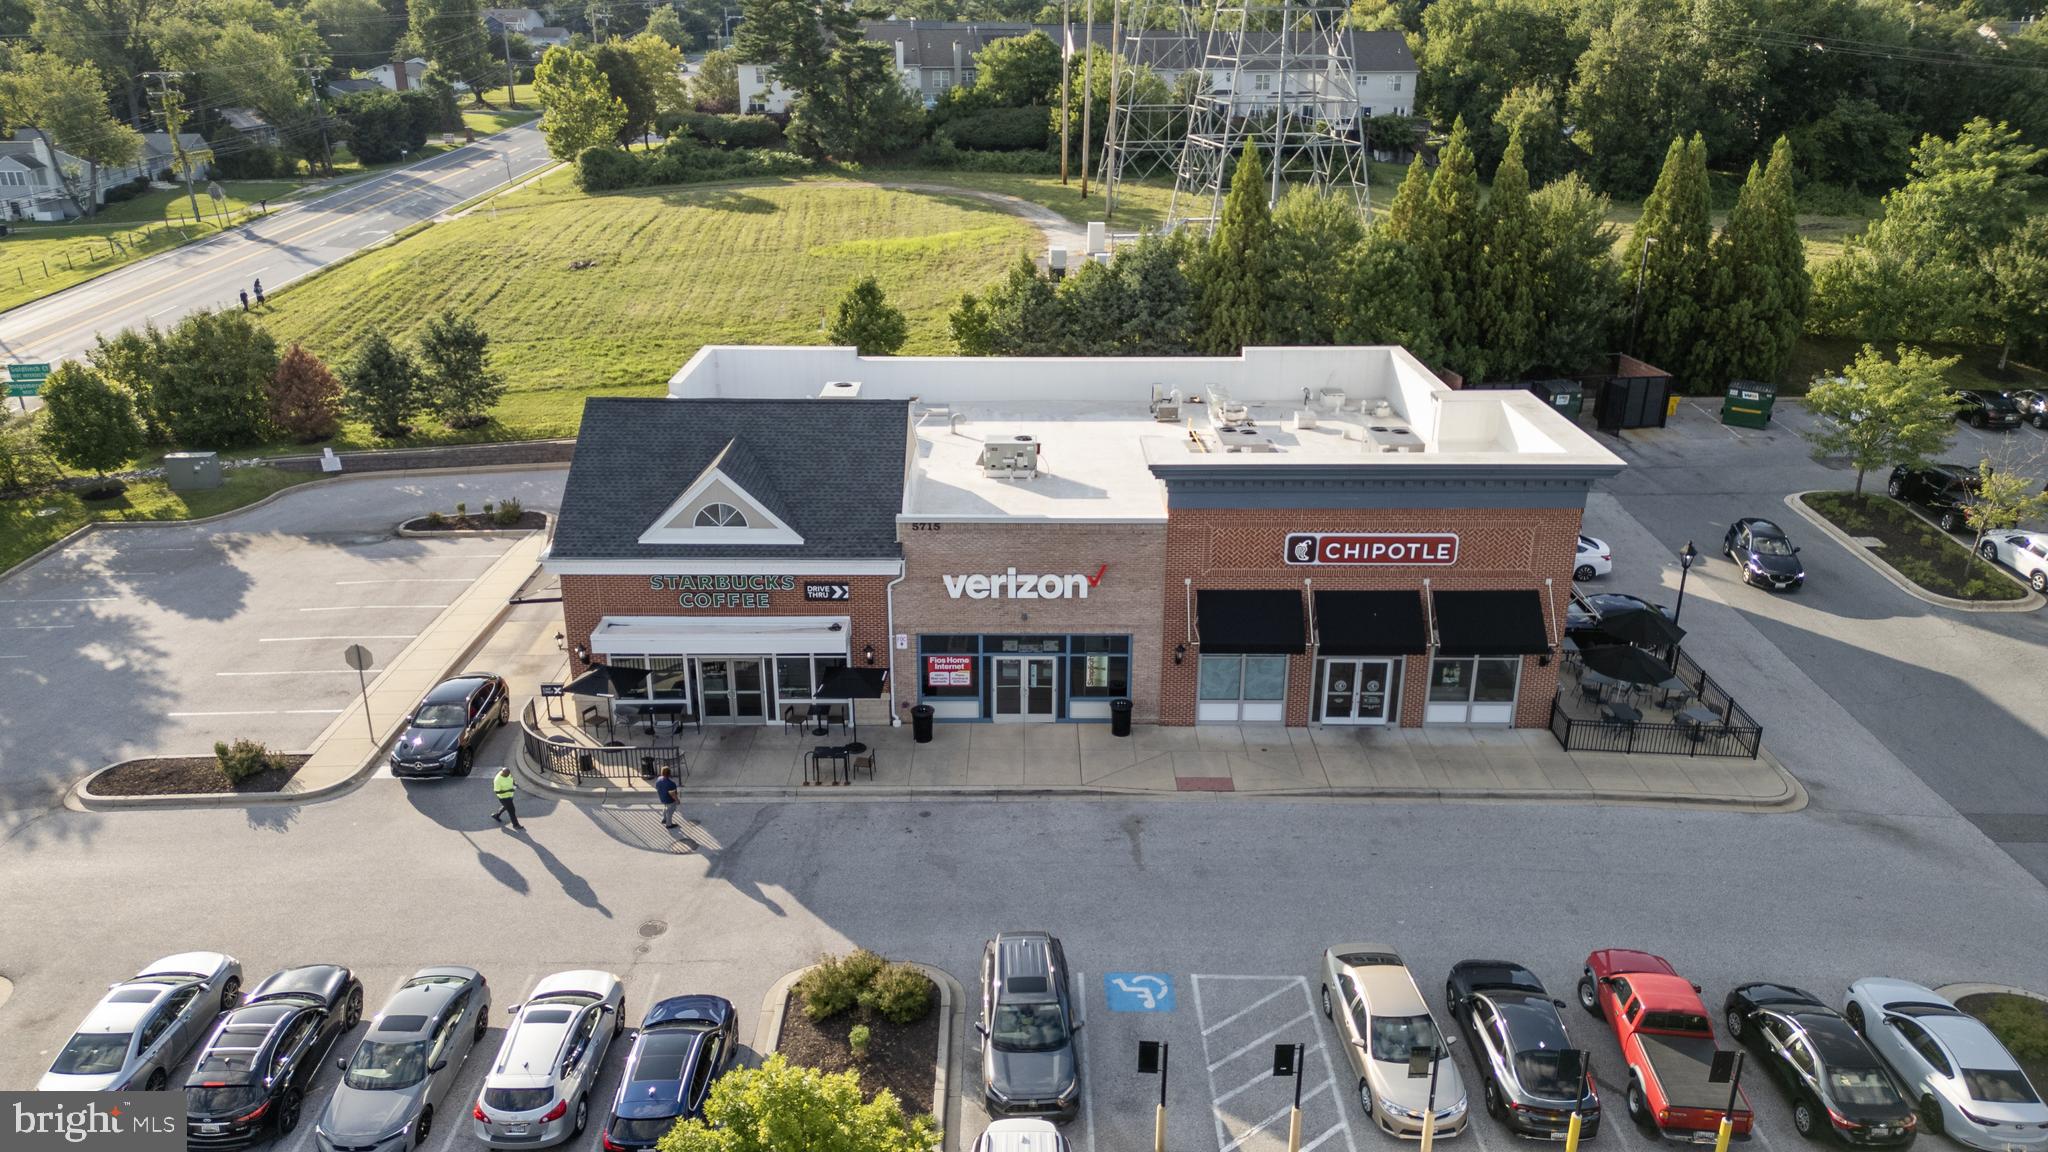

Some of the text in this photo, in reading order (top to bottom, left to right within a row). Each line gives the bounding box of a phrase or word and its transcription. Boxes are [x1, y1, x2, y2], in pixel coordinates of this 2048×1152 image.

[912, 523, 941, 531] 5715
[1325, 543, 1451, 560] CHIPOTLE
[650, 575, 796, 590] STARBUCKS
[942, 567, 1089, 600] verizon
[679, 592, 770, 608] COFFEE
[807, 591, 830, 599] THRU
[929, 656, 970, 664] Fios Home
